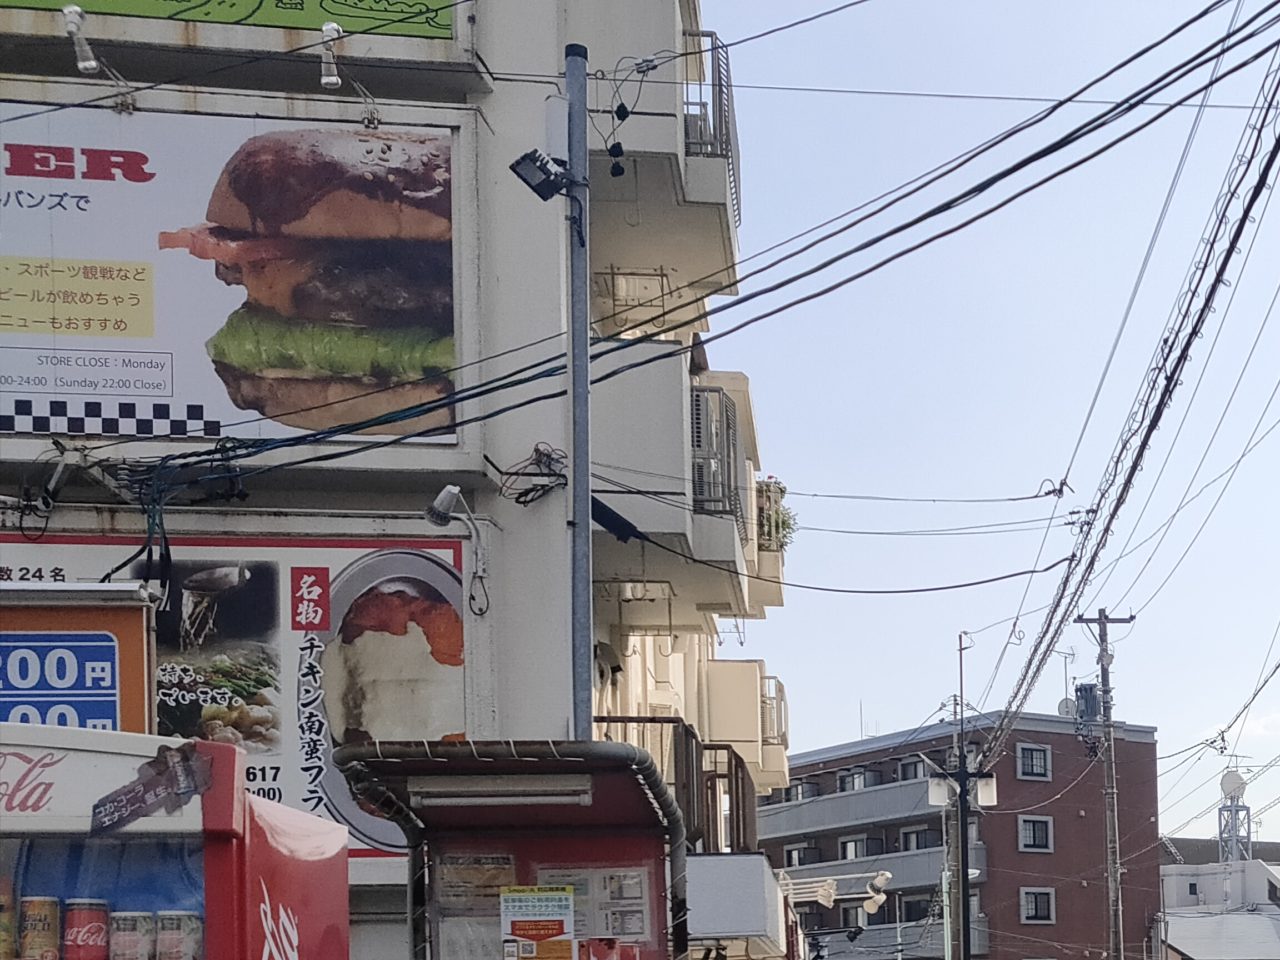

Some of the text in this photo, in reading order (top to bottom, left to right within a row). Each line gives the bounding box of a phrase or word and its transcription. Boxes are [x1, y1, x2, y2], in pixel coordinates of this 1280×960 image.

[4, 143, 157, 183] ER
[37, 355, 72, 367] STORE
[122, 358, 166, 372] Monday
[102, 379, 131, 389] 22:00
[296, 575, 323, 625] 名物
[298, 636, 325, 817] チキン南蛮フラ
[245, 766, 281, 782] 617
